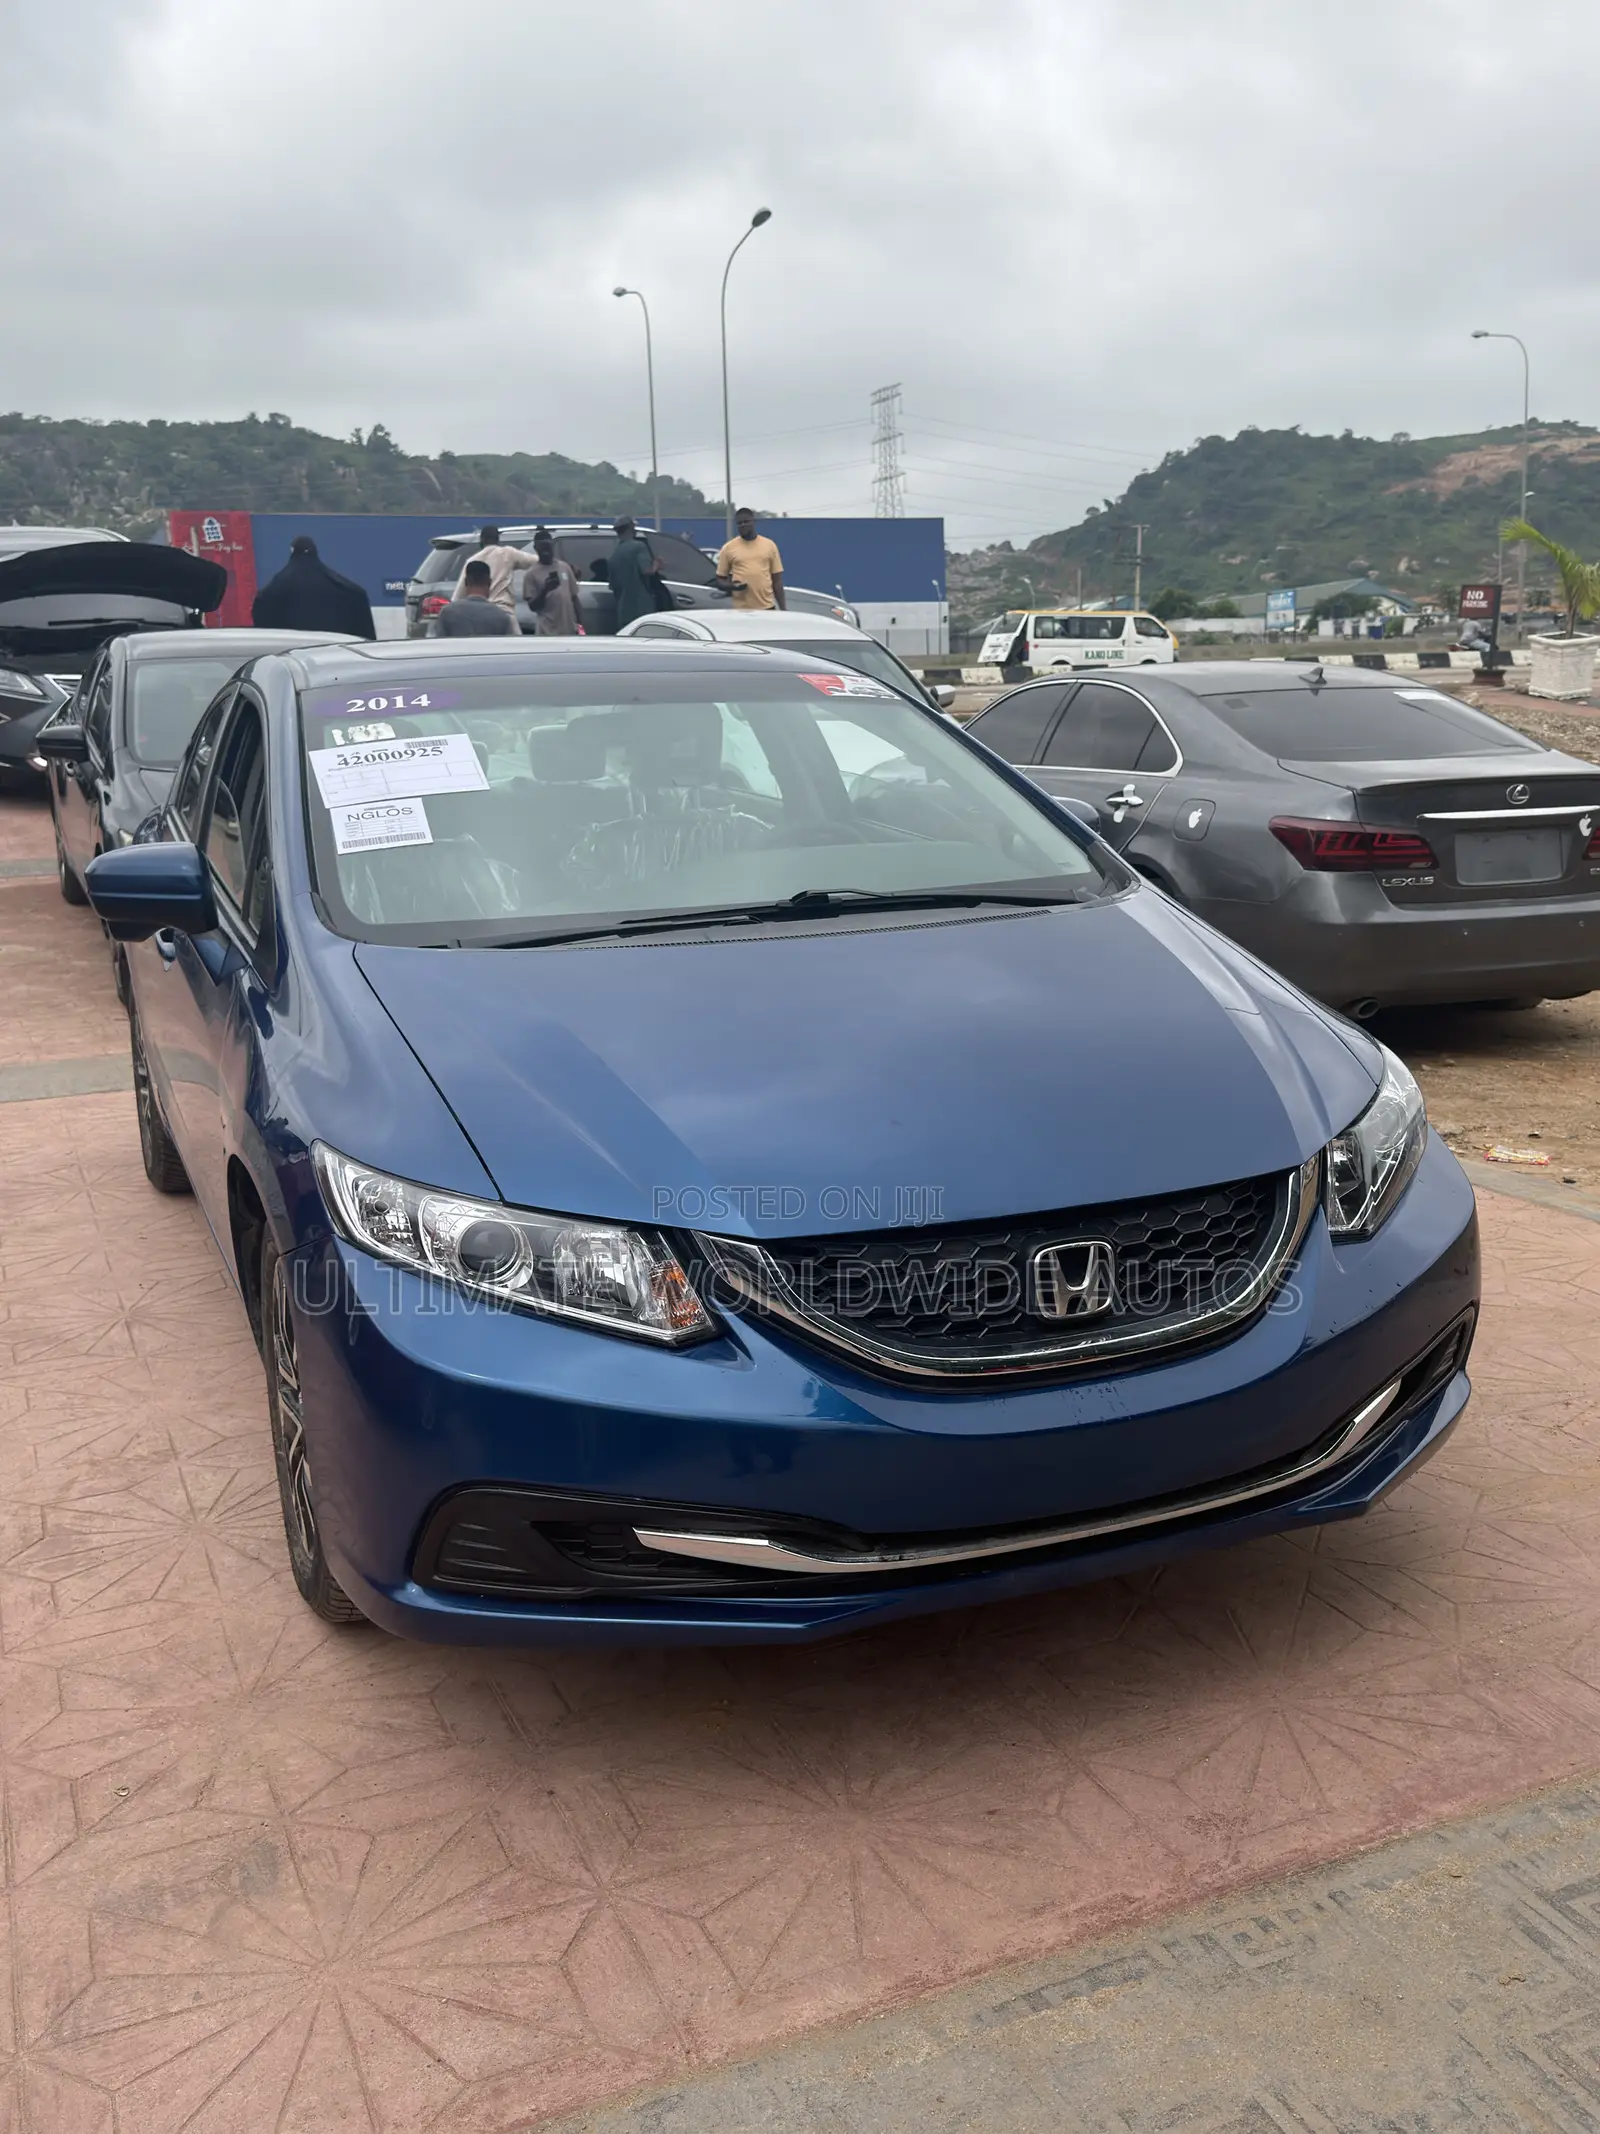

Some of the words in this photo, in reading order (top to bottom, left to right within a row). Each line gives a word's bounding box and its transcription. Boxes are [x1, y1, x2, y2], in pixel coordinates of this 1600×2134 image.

[1467, 590, 1485, 600] NO
[1462, 600, 1489, 608] PARKING
[1084, 650, 1106, 659] KANO
[346, 693, 431, 713] 2014
[337, 746, 443, 767] 42000925
[347, 807, 413, 822] NGLOS
[1382, 877, 1434, 887] LEXUS
